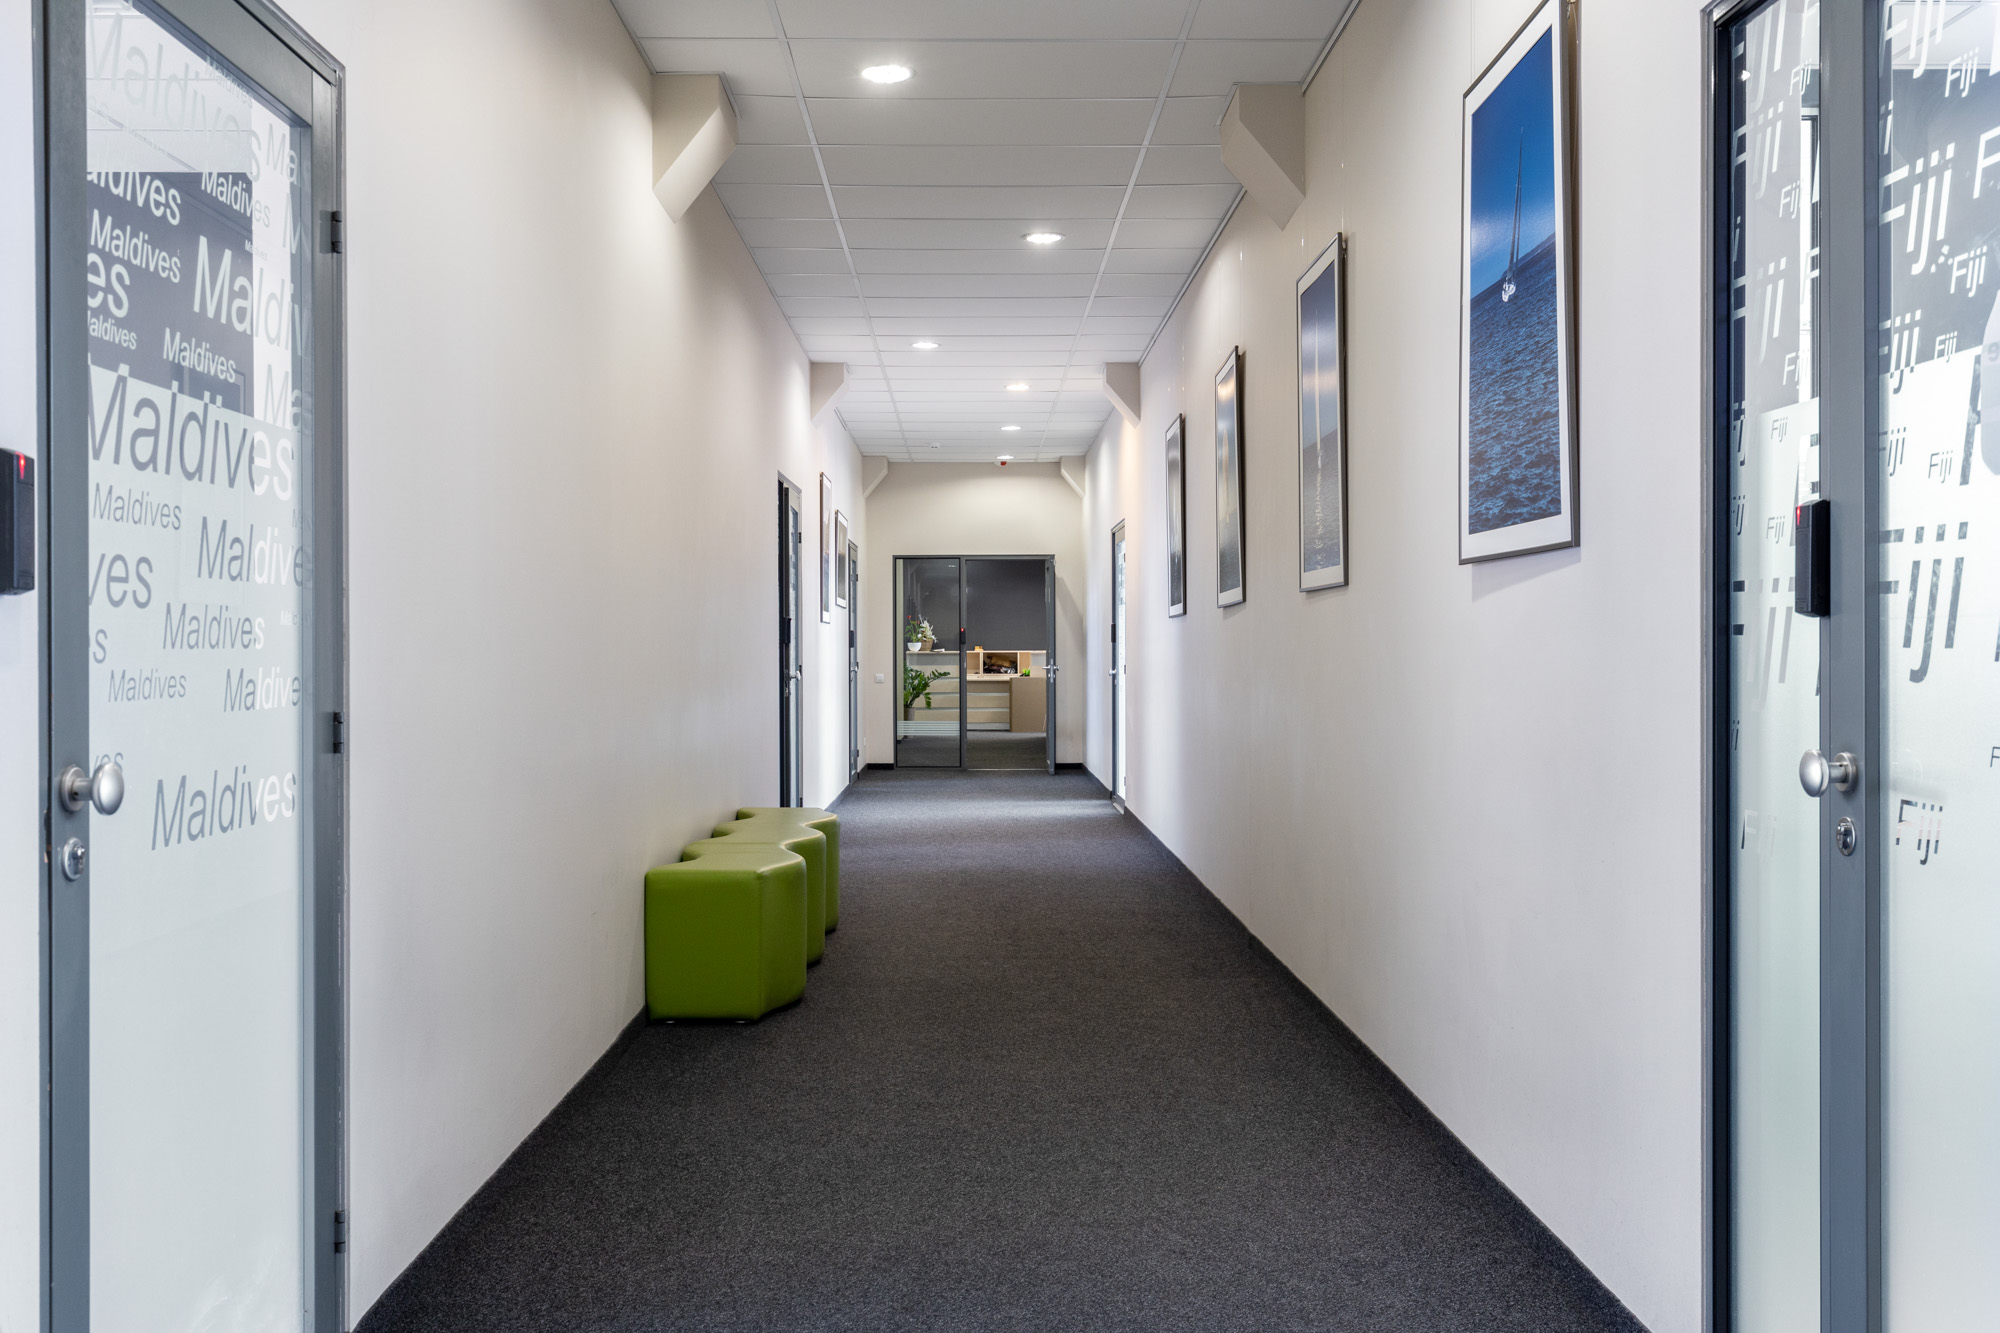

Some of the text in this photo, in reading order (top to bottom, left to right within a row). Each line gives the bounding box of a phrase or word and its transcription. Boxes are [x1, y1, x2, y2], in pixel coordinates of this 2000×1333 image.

[1789, 57, 1812, 95] Fiji
[1945, 46, 1979, 97] Fiji
[91, 208, 181, 284] Maldives
[1950, 246, 1987, 298] Fiji
[88, 310, 137, 350] aldives
[1934, 331, 1957, 363] Fiji
[163, 327, 236, 383] Maldives
[1770, 416, 1788, 442] Fiji
[1928, 450, 1954, 483] Fiji
[93, 482, 182, 531] Maldives
[1766, 515, 1785, 544] Fiji
[163, 602, 265, 650] Maldives
[108, 668, 187, 702] Maldives
[152, 765, 296, 851] Maldives
[1896, 799, 1943, 866] Fiji
